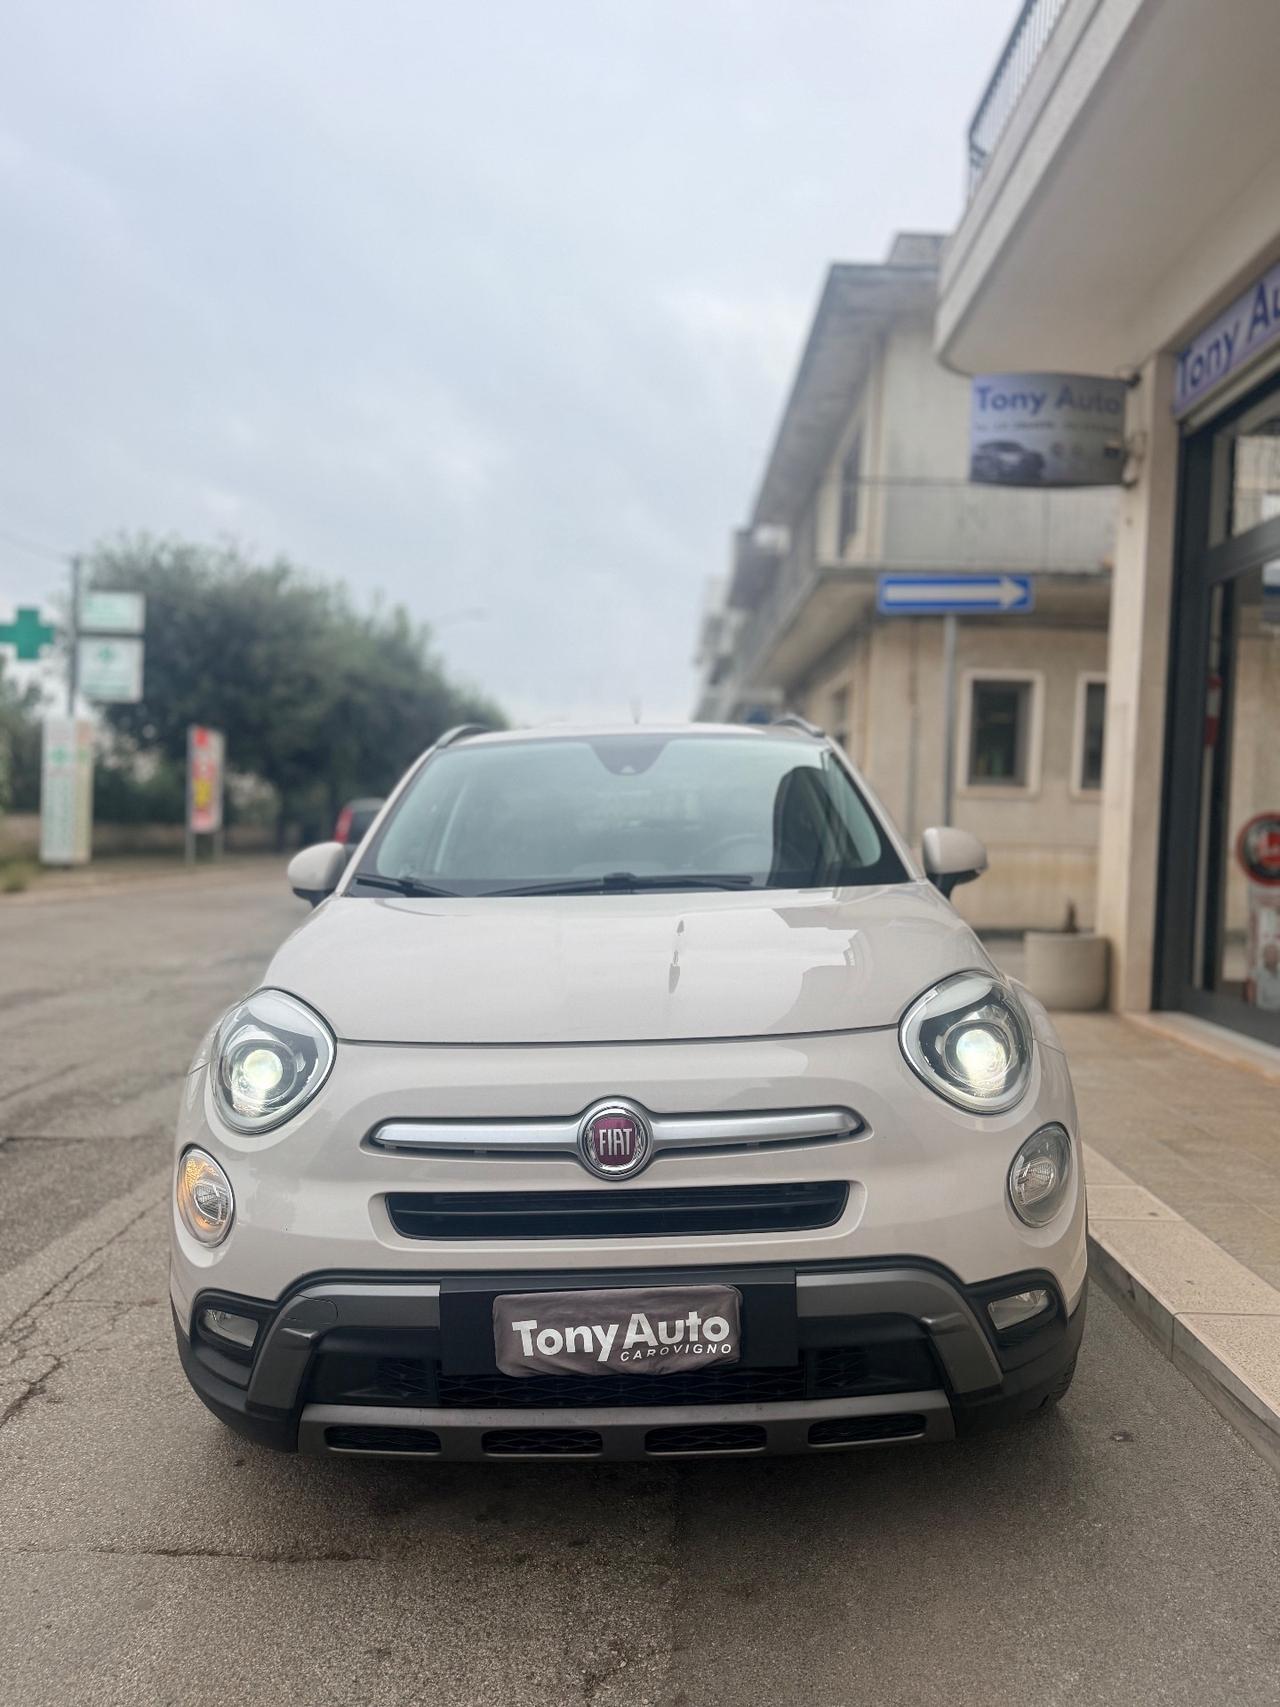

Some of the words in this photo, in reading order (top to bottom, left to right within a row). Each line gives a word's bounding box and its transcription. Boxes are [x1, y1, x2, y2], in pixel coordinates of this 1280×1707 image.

[1176, 319, 1240, 397] Tony
[975, 385, 1045, 415] Tony
[1055, 383, 1121, 414] Auto
[599, 1128, 632, 1156] FIAT
[620, 1343, 731, 1362] CAROVIGNO
